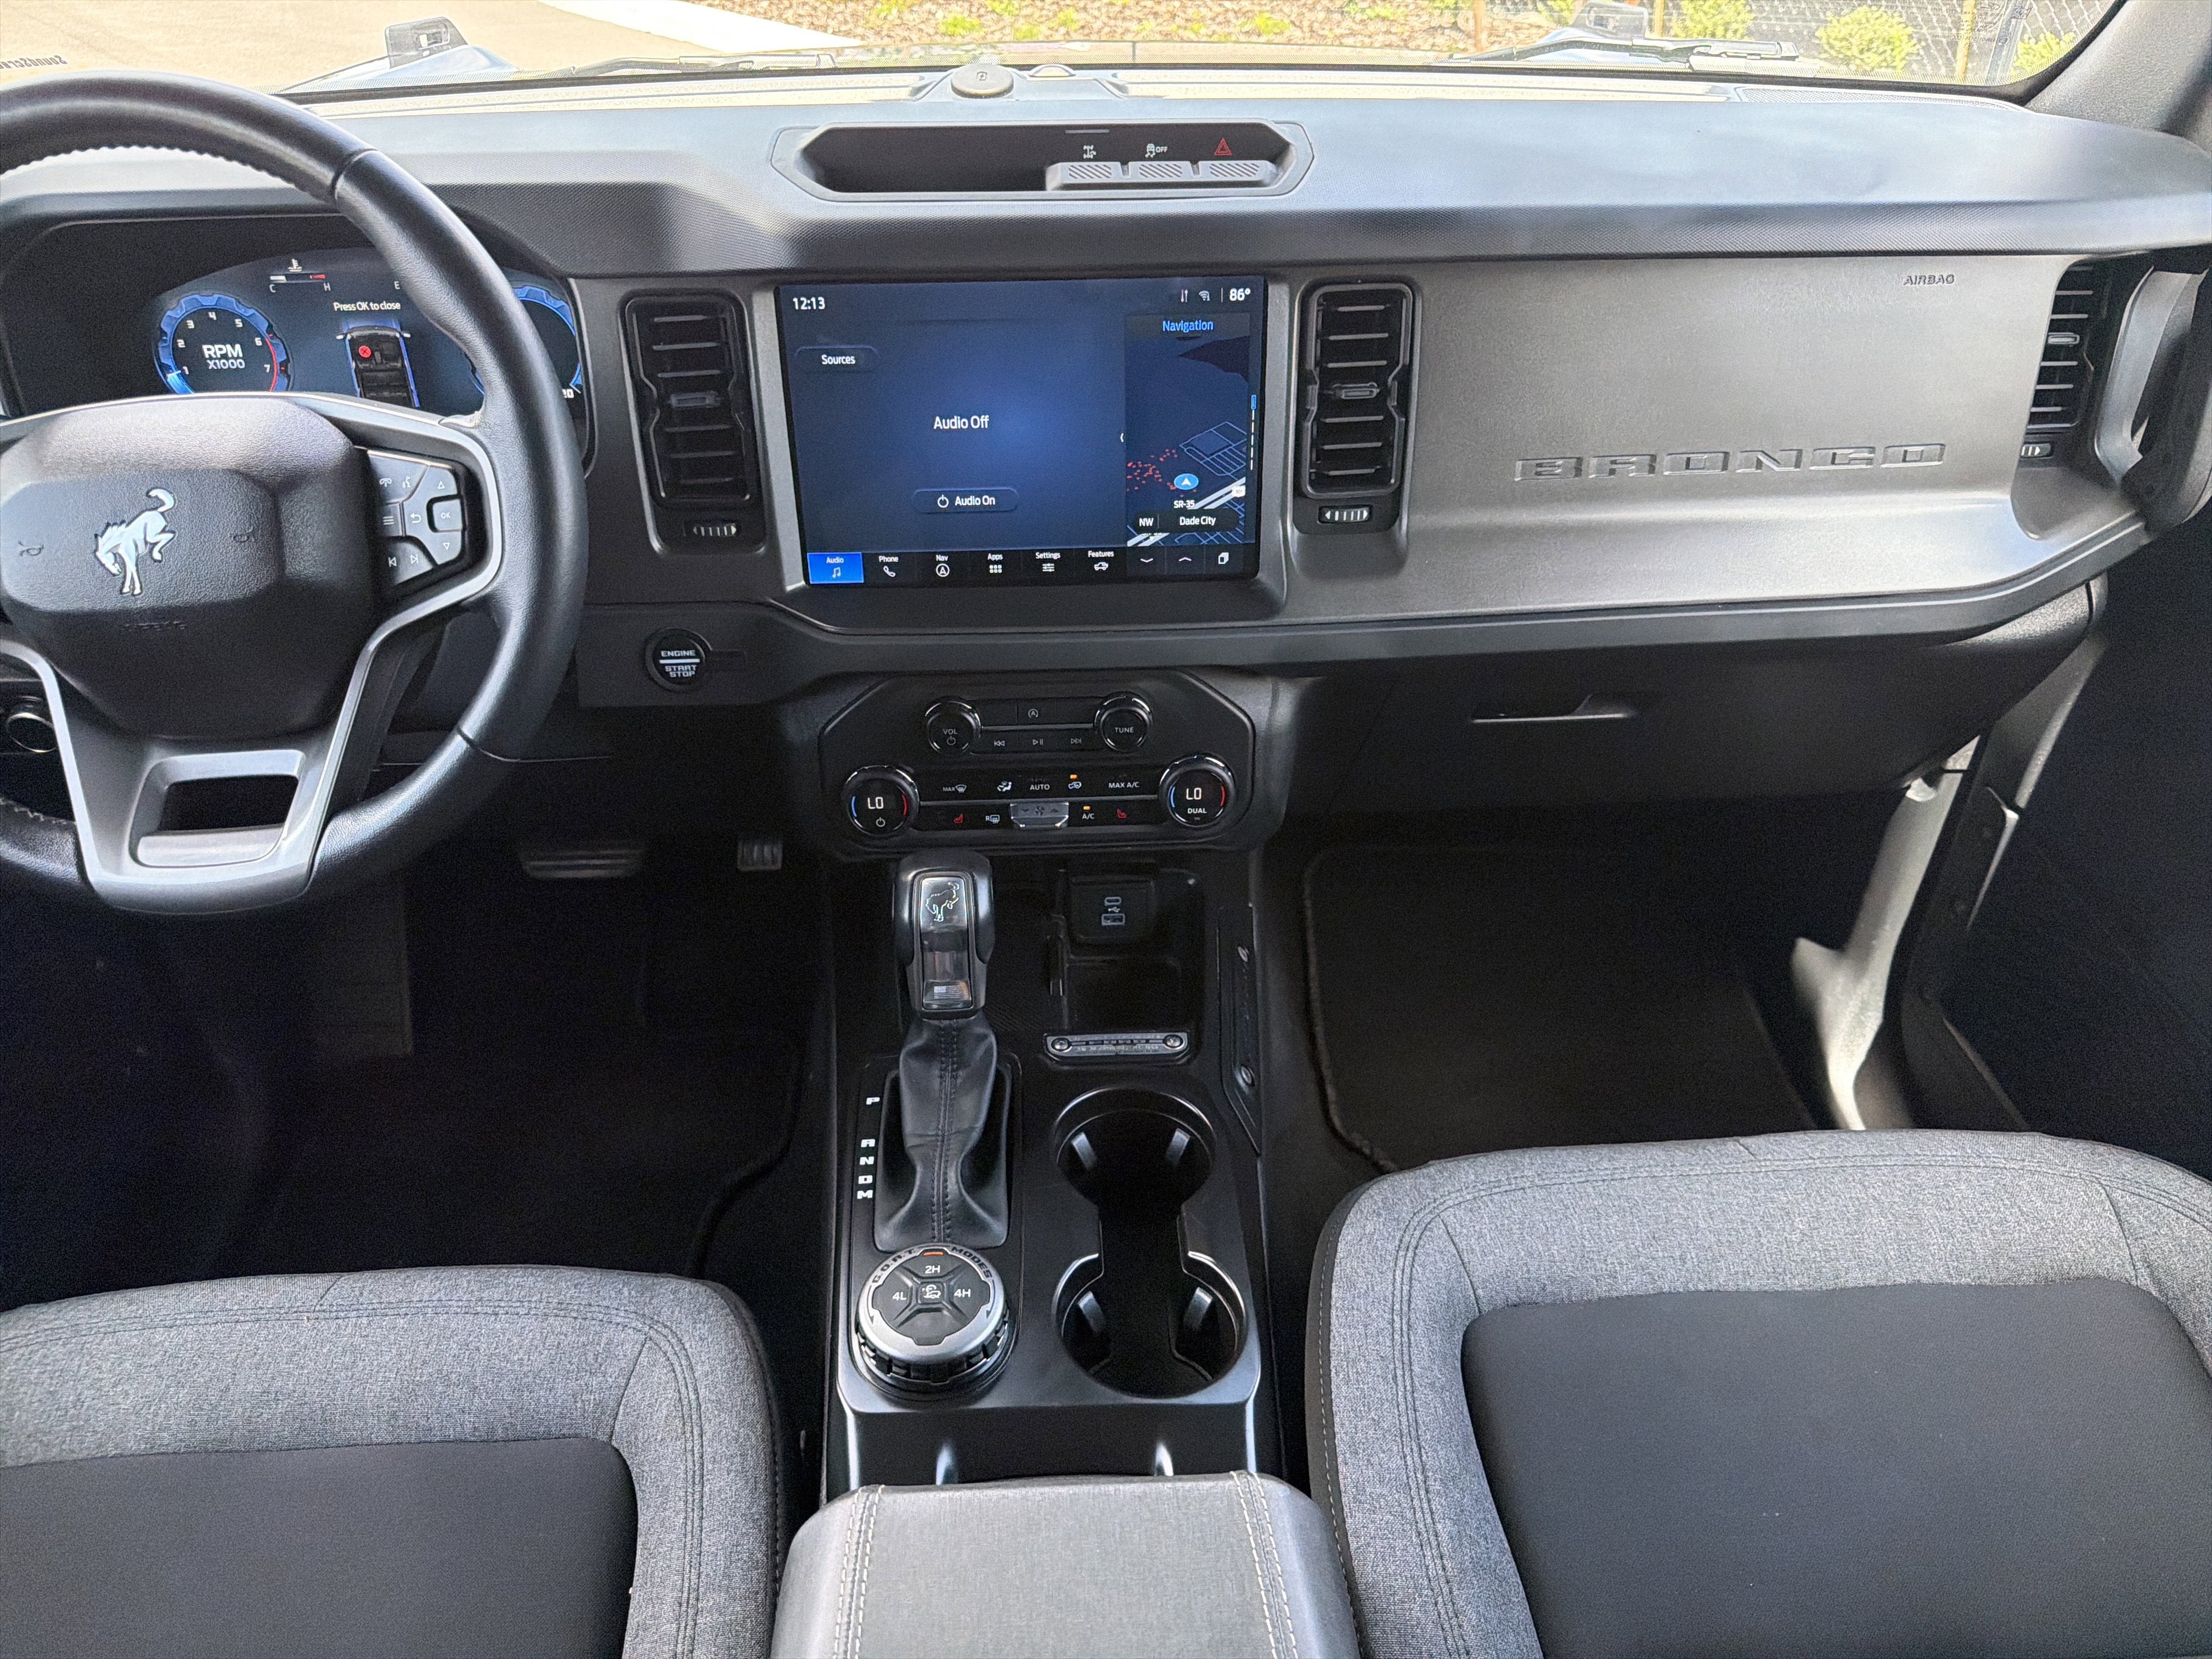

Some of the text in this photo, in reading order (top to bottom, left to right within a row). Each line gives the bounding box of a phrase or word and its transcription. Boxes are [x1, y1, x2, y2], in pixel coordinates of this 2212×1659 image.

[1903, 274, 1954, 285] AIRBAG
[269, 284, 276, 293] C
[324, 283, 331, 291] H
[333, 301, 401, 312] Press OK to close
[793, 296, 826, 310] 12:13
[208, 312, 217, 320] 4
[186, 319, 195, 329] 3
[234, 318, 243, 328] 5
[1163, 319, 1214, 333] Navigation
[177, 339, 185, 348] 2
[255, 337, 263, 346] 6
[202, 344, 243, 358] RPM
[206, 359, 245, 370] X1000
[821, 354, 856, 365] Sources
[183, 366, 189, 375] 1
[264, 364, 270, 373] 7
[933, 415, 990, 430] Audio Off
[1514, 443, 1946, 481] BRONCO
[955, 495, 996, 506] Audio On
[1173, 500, 1195, 509] SR-35
[1139, 517, 1154, 527] NW
[1180, 516, 1216, 526] Dade City
[866, 1097, 881, 1105] P
[860, 1156, 874, 1165] N
[858, 1175, 873, 1184] D
[857, 1189, 873, 1199] M
[951, 1246, 993, 1278] MODES
[924, 1265, 941, 1274] 2H
[892, 1291, 907, 1301] 4L
[953, 1288, 971, 1298] 4H
